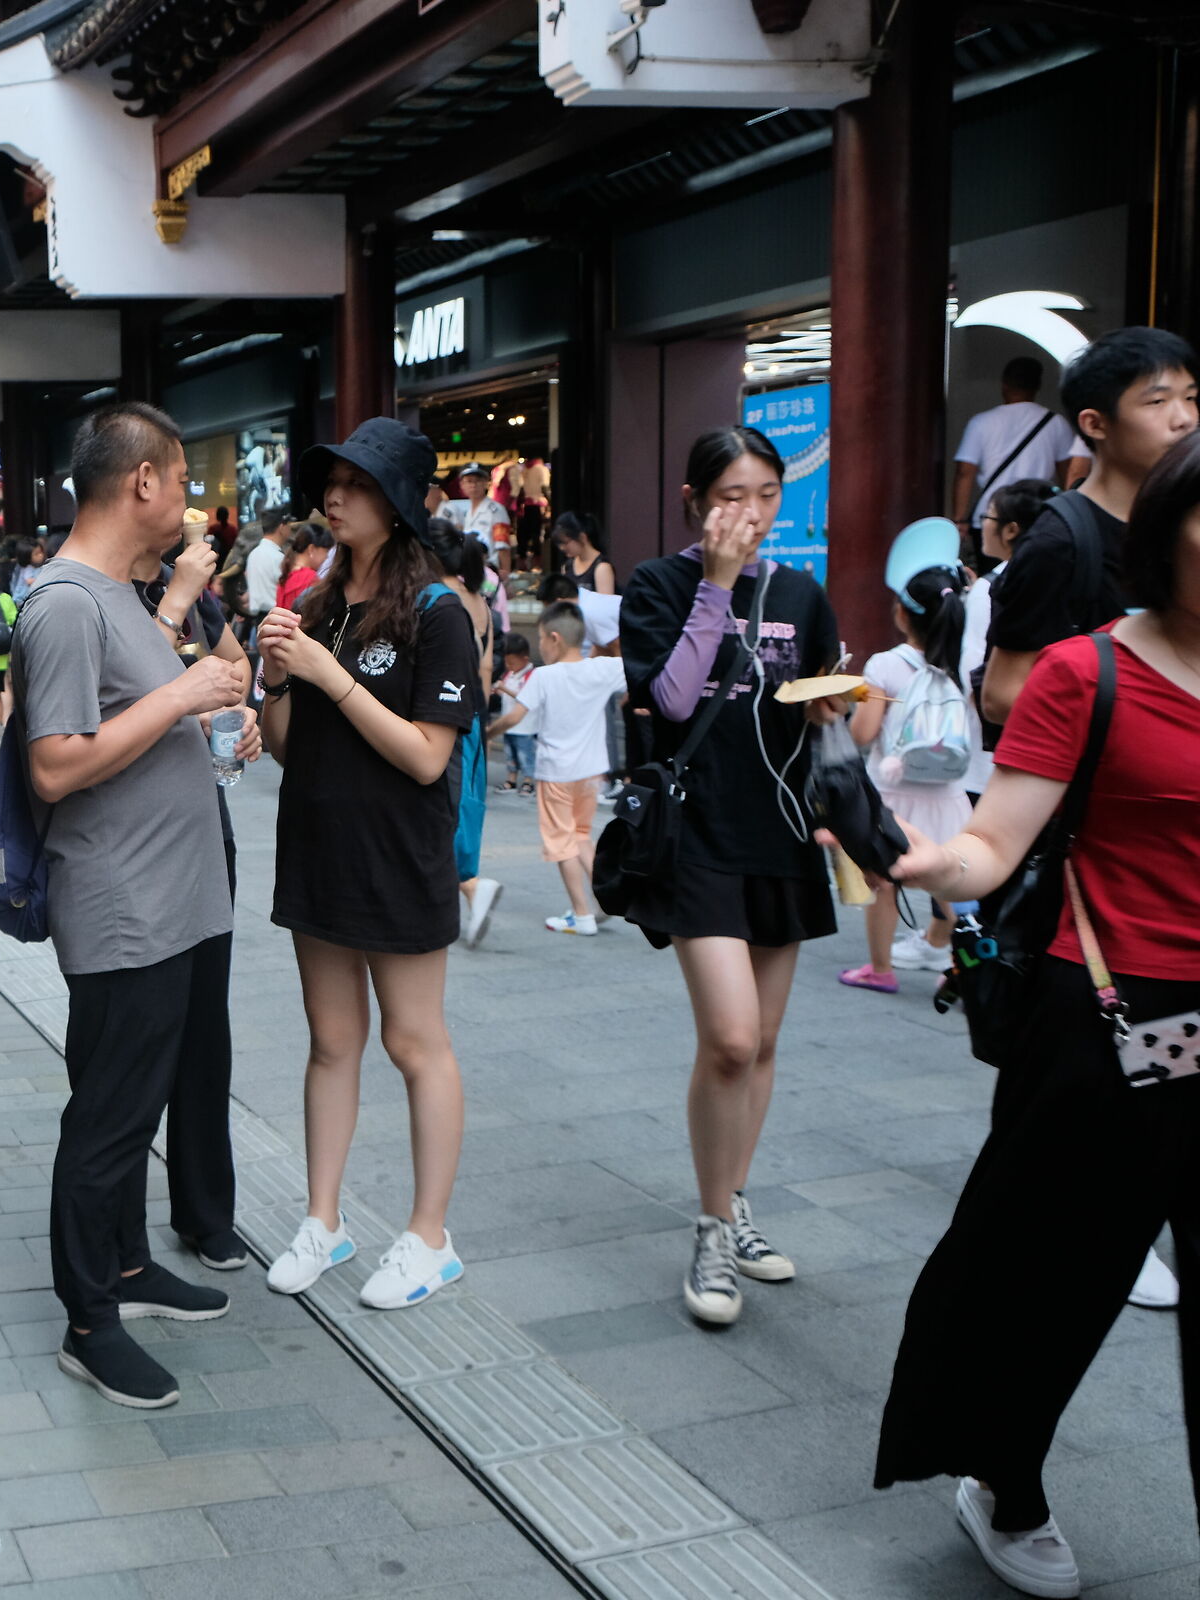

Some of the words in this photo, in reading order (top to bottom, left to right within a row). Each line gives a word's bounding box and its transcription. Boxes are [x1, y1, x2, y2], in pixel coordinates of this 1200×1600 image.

[405, 297, 464, 366] ANTA
[746, 409, 763, 424] 2F
[765, 421, 816, 438] LisaPearl
